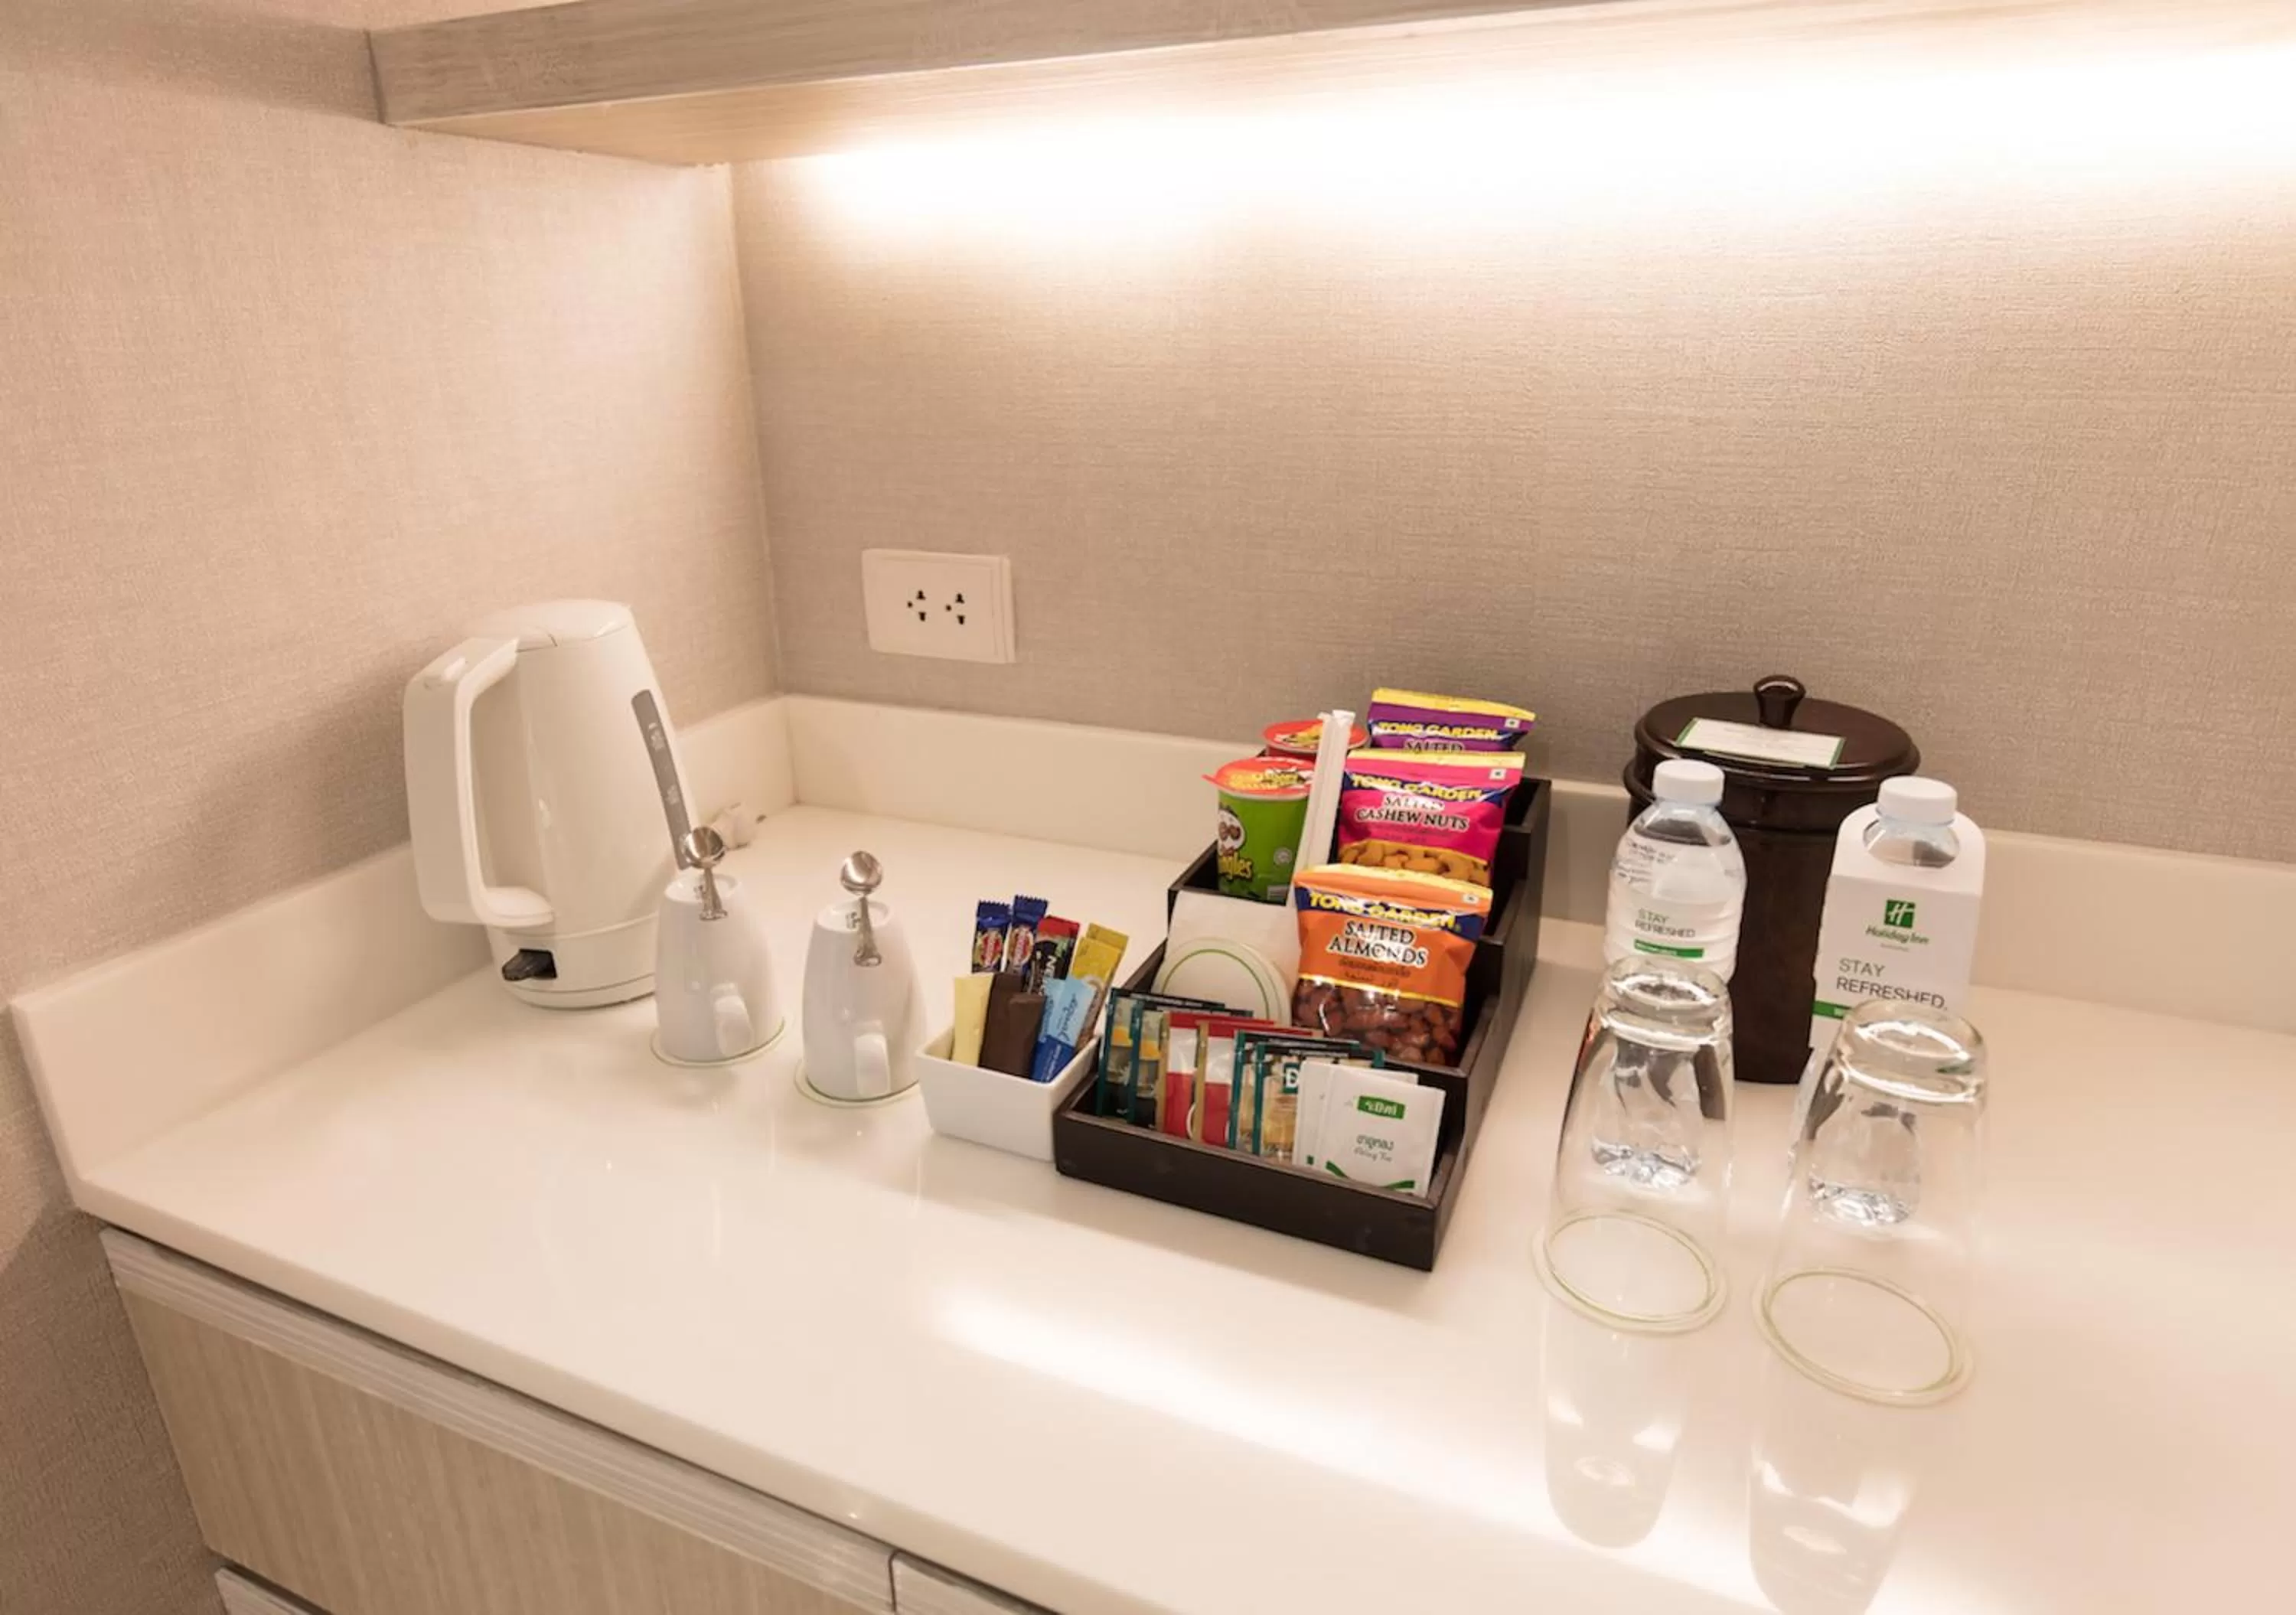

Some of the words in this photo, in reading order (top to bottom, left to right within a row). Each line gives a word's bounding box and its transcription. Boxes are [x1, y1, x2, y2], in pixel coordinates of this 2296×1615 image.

[1378, 722, 1424, 735] TONG
[1425, 724, 1498, 740] GARDEN
[1406, 739, 1463, 752] SALTED
[1352, 774, 1401, 788] TONG
[1407, 783, 1482, 801] GARDEN
[1384, 794, 1443, 810] SALTED
[1357, 808, 1422, 823] CASHEW
[1424, 814, 1469, 830] NUTS
[1309, 892, 1364, 914] TONG
[1368, 905, 1456, 928] GARDEN
[1637, 909, 1670, 923] STAY
[1345, 920, 1415, 945] SALTED
[1865, 925, 1910, 944] Holiday
[1910, 932, 1929, 944] Inn
[1328, 936, 1427, 966] ALMONDS
[1839, 958, 1886, 977] STAY
